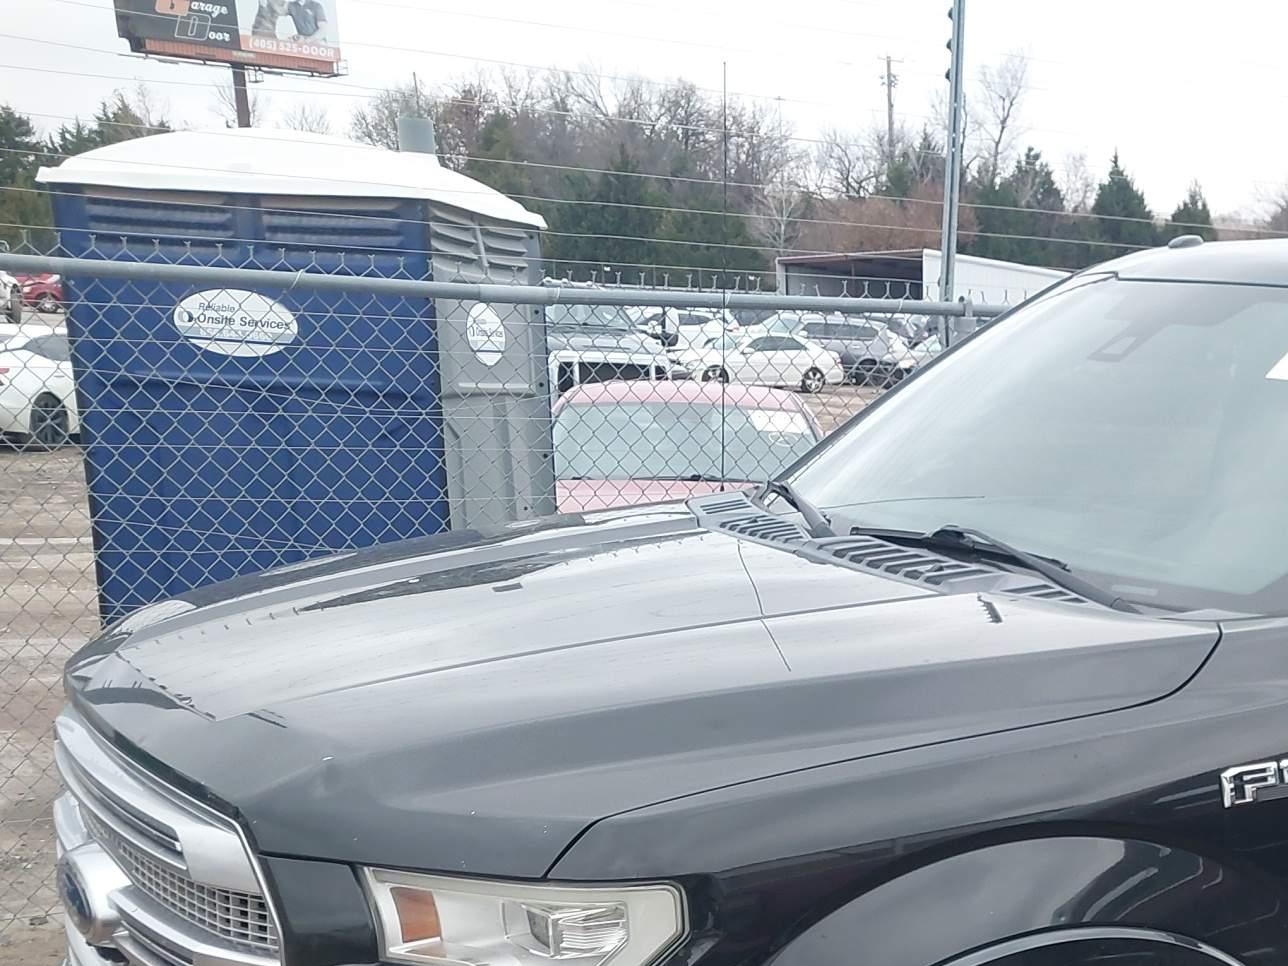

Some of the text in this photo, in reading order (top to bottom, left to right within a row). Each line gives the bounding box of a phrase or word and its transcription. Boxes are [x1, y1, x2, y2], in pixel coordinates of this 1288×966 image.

[174, 12, 231, 42] Door
[198, 302, 236, 313] Reliable
[197, 313, 291, 330] Onsite Services
